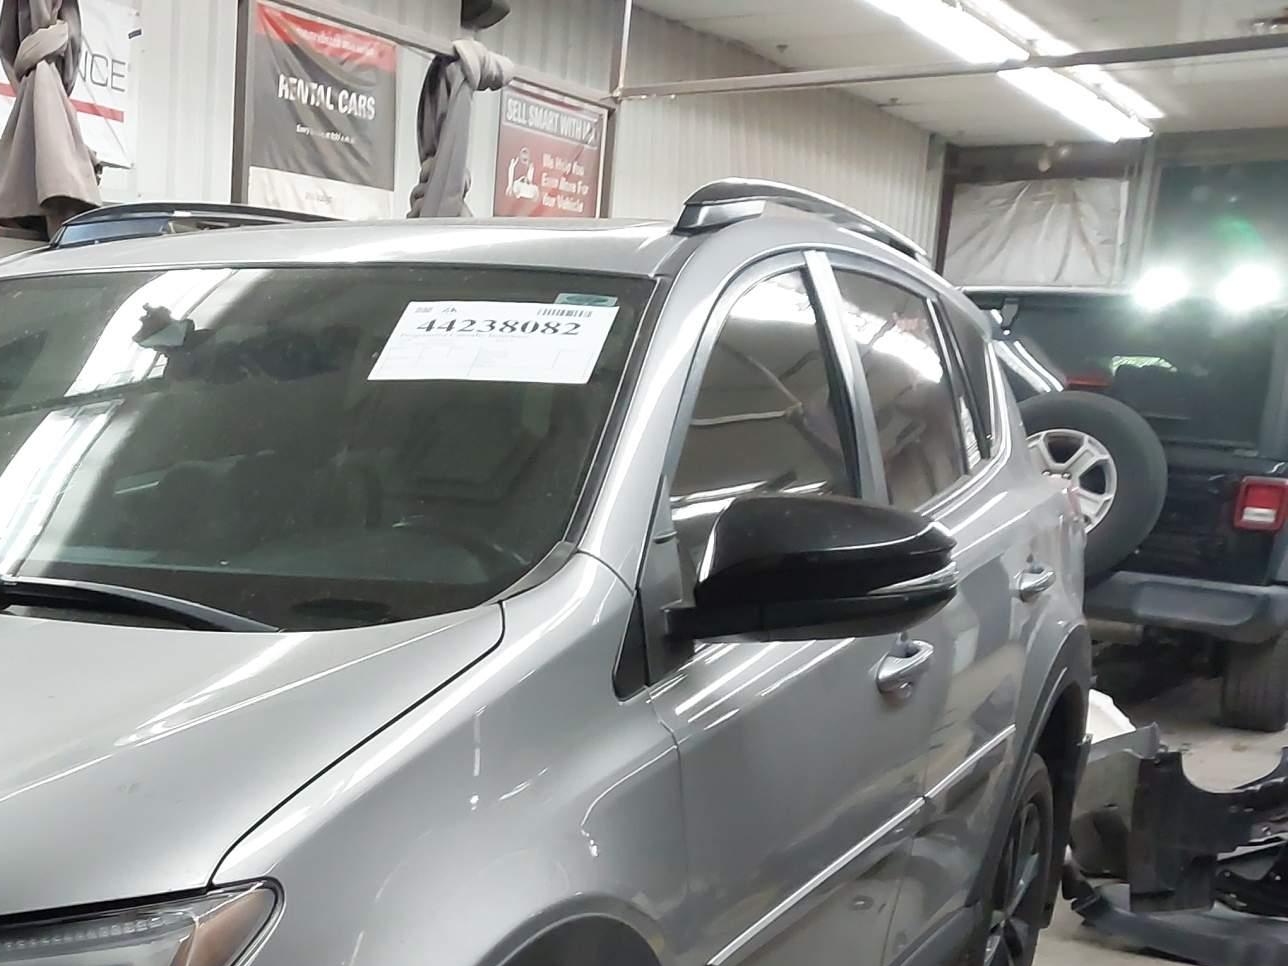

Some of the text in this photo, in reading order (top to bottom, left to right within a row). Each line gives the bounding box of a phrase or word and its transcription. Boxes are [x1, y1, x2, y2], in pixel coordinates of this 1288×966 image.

[278, 74, 376, 120] RENTAL CARS
[506, 98, 527, 125] SELL
[528, 104, 560, 133] SMART
[416, 319, 582, 336] 44238082
